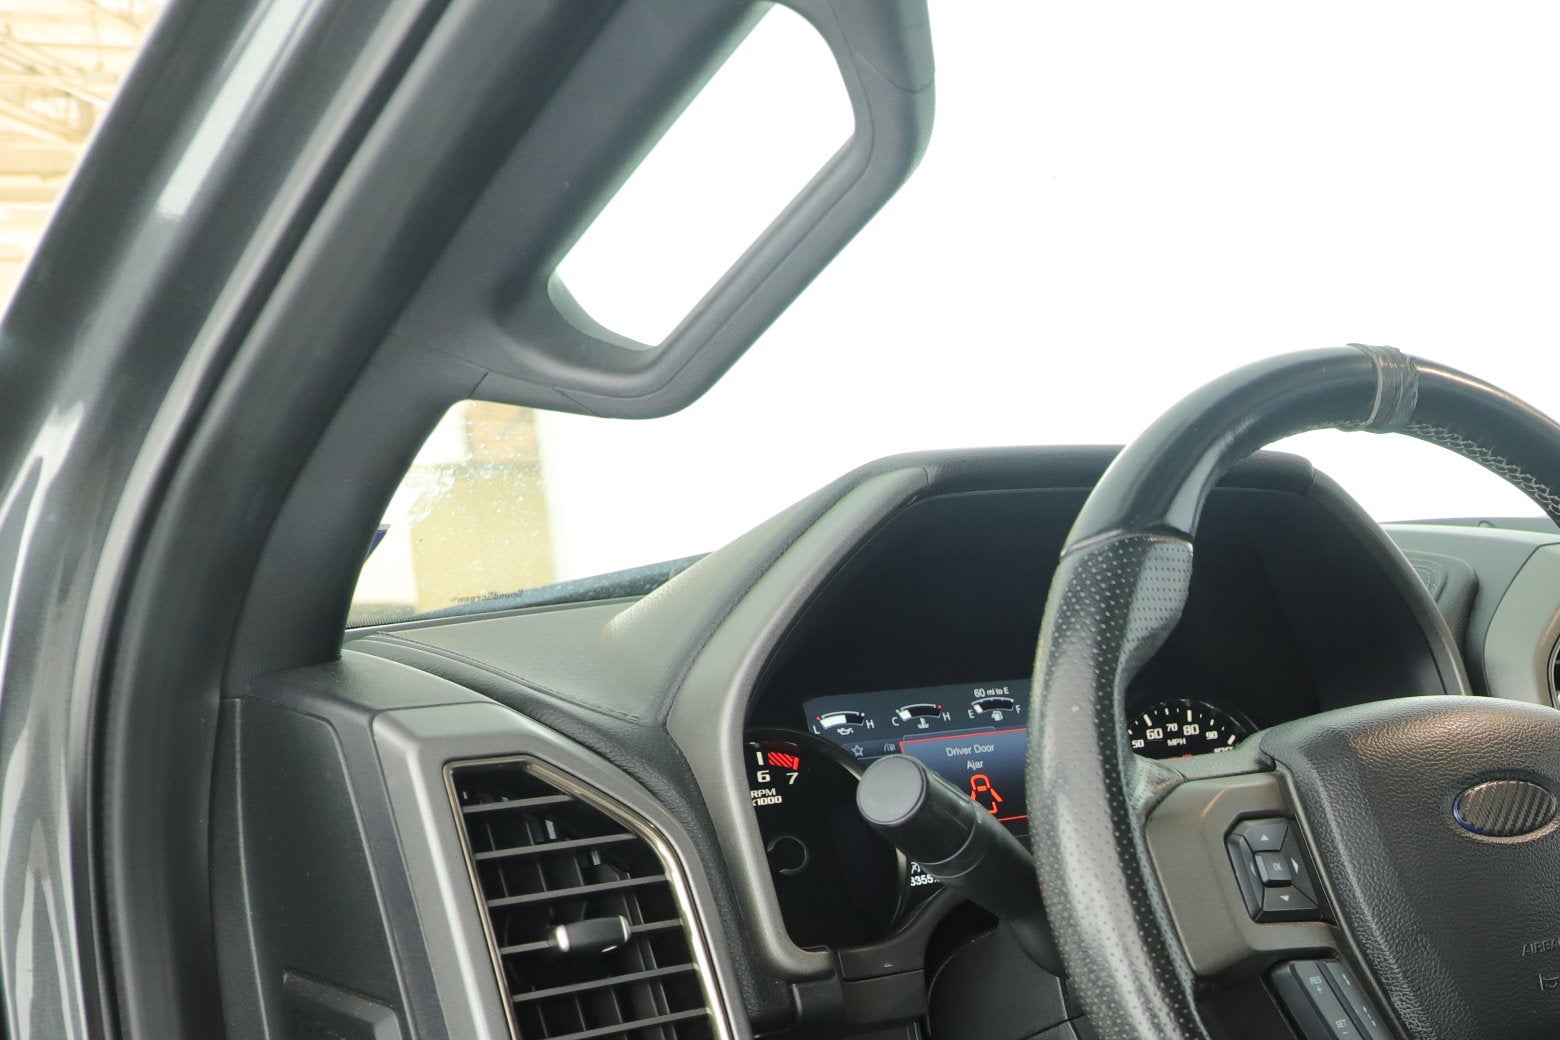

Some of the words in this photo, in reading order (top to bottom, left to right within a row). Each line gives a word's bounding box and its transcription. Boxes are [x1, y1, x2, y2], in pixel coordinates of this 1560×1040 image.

[973, 688, 985, 697] 60
[986, 688, 995, 696] mi
[1003, 686, 1009, 695] E
[967, 709, 975, 718] E
[1016, 704, 1022, 714] F
[891, 716, 899, 726] C
[942, 711, 951, 721] H
[866, 719, 875, 729] H
[1166, 723, 1178, 732] 70
[813, 725, 820, 735] L
[1146, 728, 1164, 740] 60
[1182, 723, 1200, 736] 80
[1205, 730, 1218, 740] 90
[1132, 739, 1145, 749] 50
[1167, 737, 1187, 747] MPH
[946, 745, 971, 757] Driver
[973, 743, 995, 754] Door
[966, 760, 983, 770] Ajar
[756, 770, 771, 783] 6
[786, 772, 799, 785] 7
[750, 787, 777, 799] RPM
